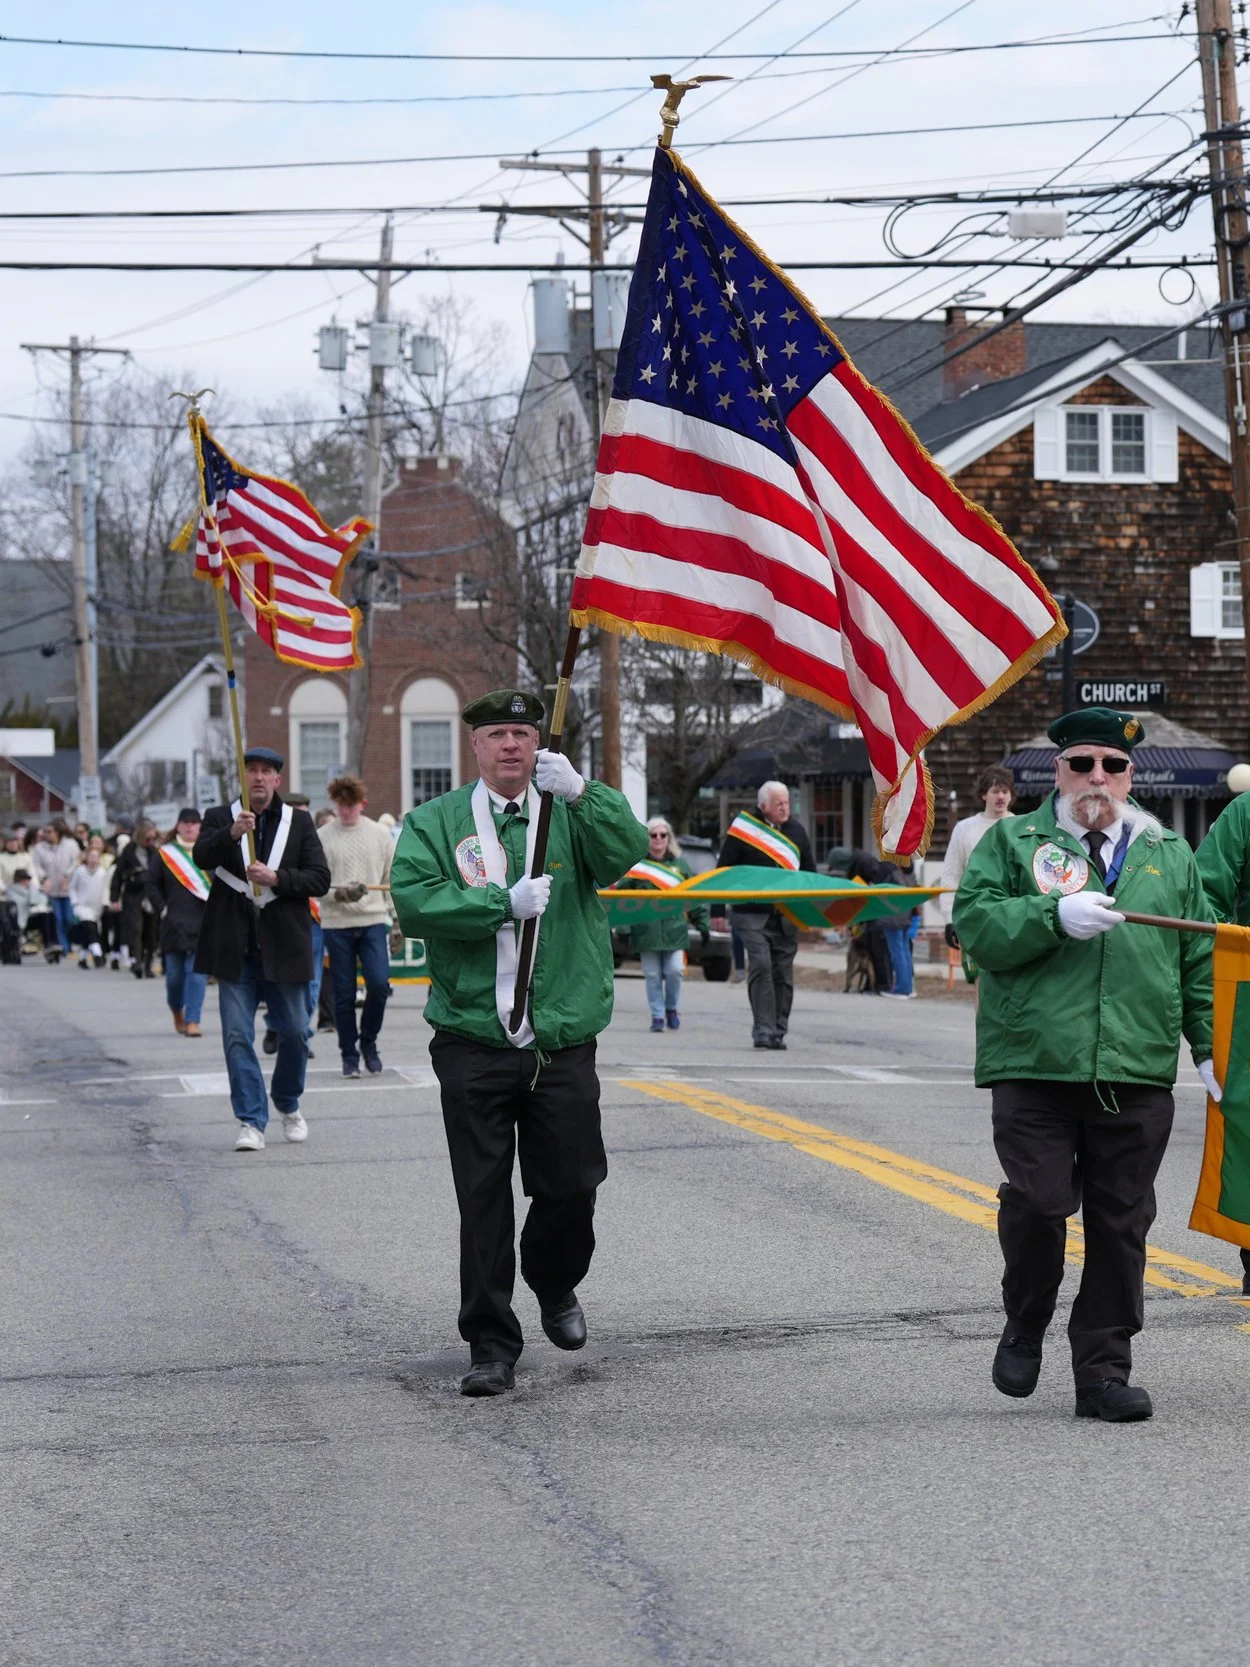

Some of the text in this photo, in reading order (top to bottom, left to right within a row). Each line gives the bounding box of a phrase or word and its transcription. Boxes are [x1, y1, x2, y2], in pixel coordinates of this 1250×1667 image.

[1081, 683, 1161, 702] CHURCH ST
[1132, 769, 1176, 784] ocktails
